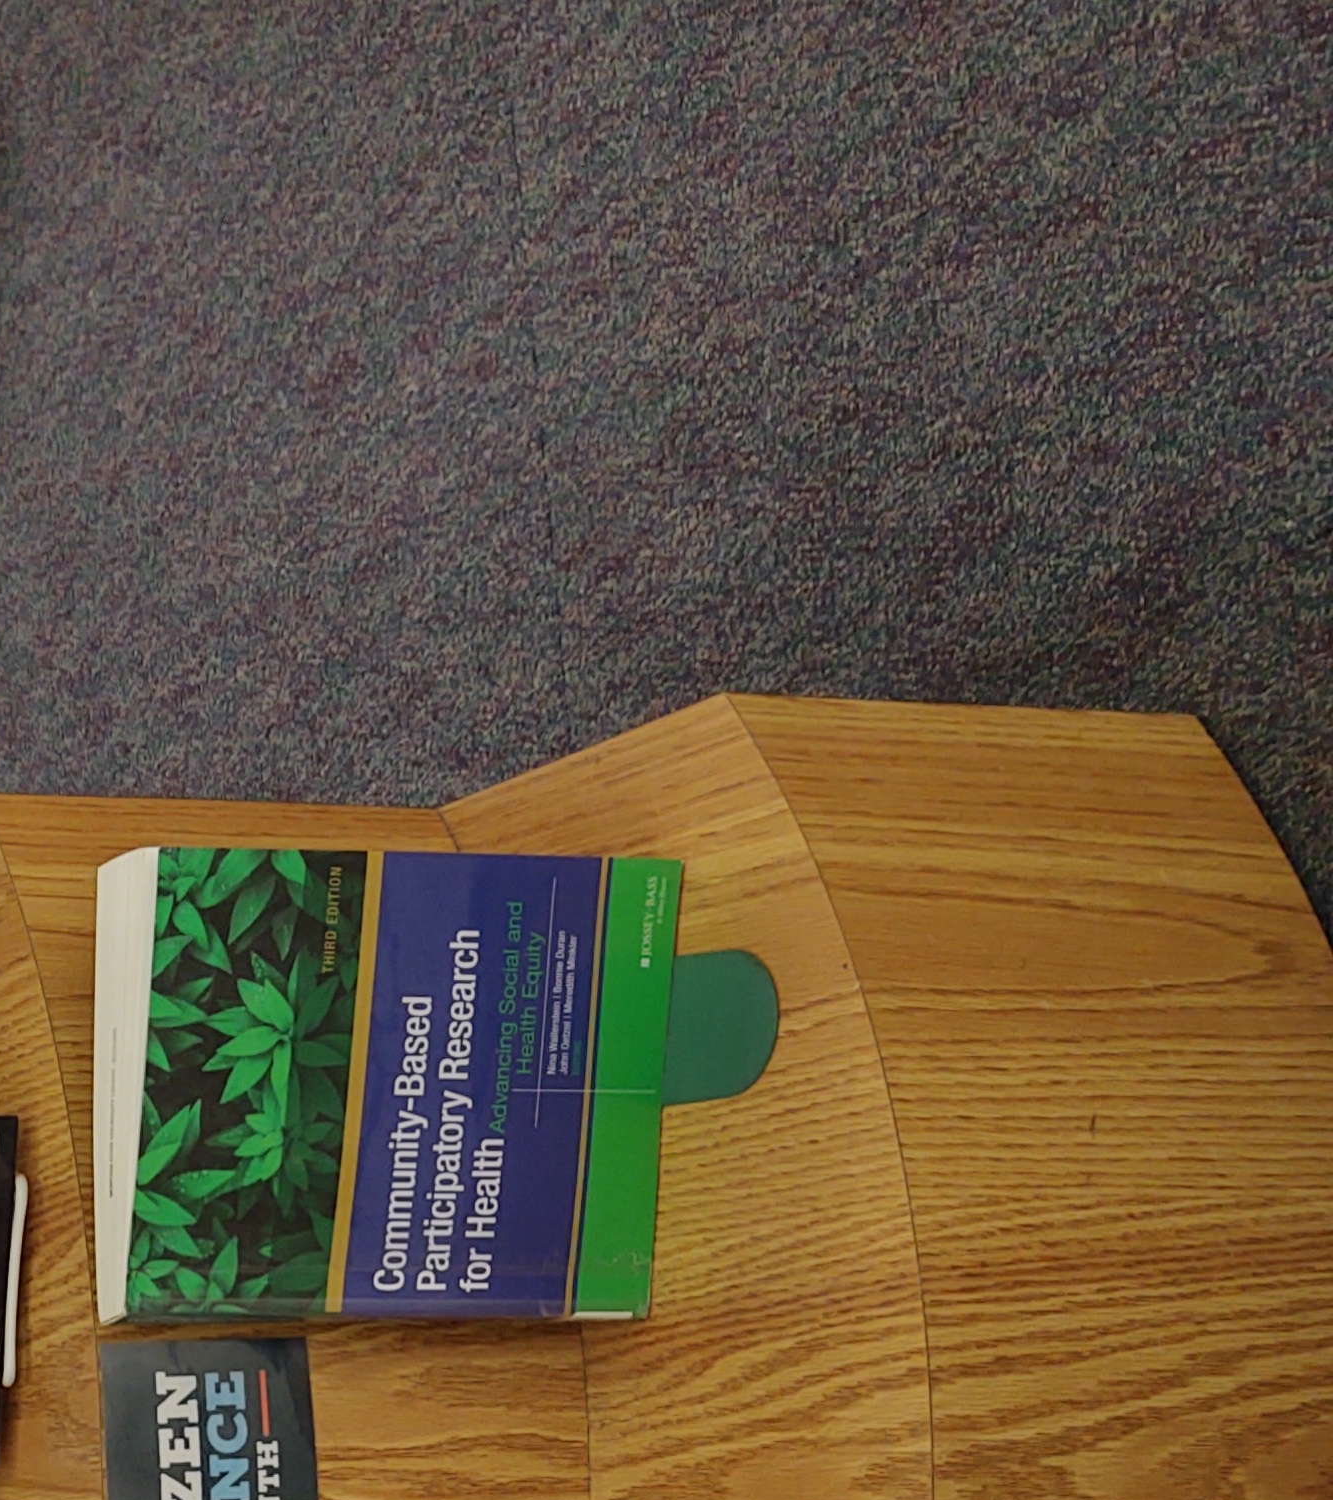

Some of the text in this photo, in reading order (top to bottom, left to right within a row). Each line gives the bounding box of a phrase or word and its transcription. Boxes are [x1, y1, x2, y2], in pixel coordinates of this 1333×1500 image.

[321, 866, 342, 973] THIRD EDITION
[516, 932, 544, 1075] Health Equity
[417, 930, 480, 1292] Participatory Research
[488, 902, 523, 1133] Advancing Social and
[373, 996, 432, 1292] Community-Based
[460, 1138, 505, 1292] for Health
